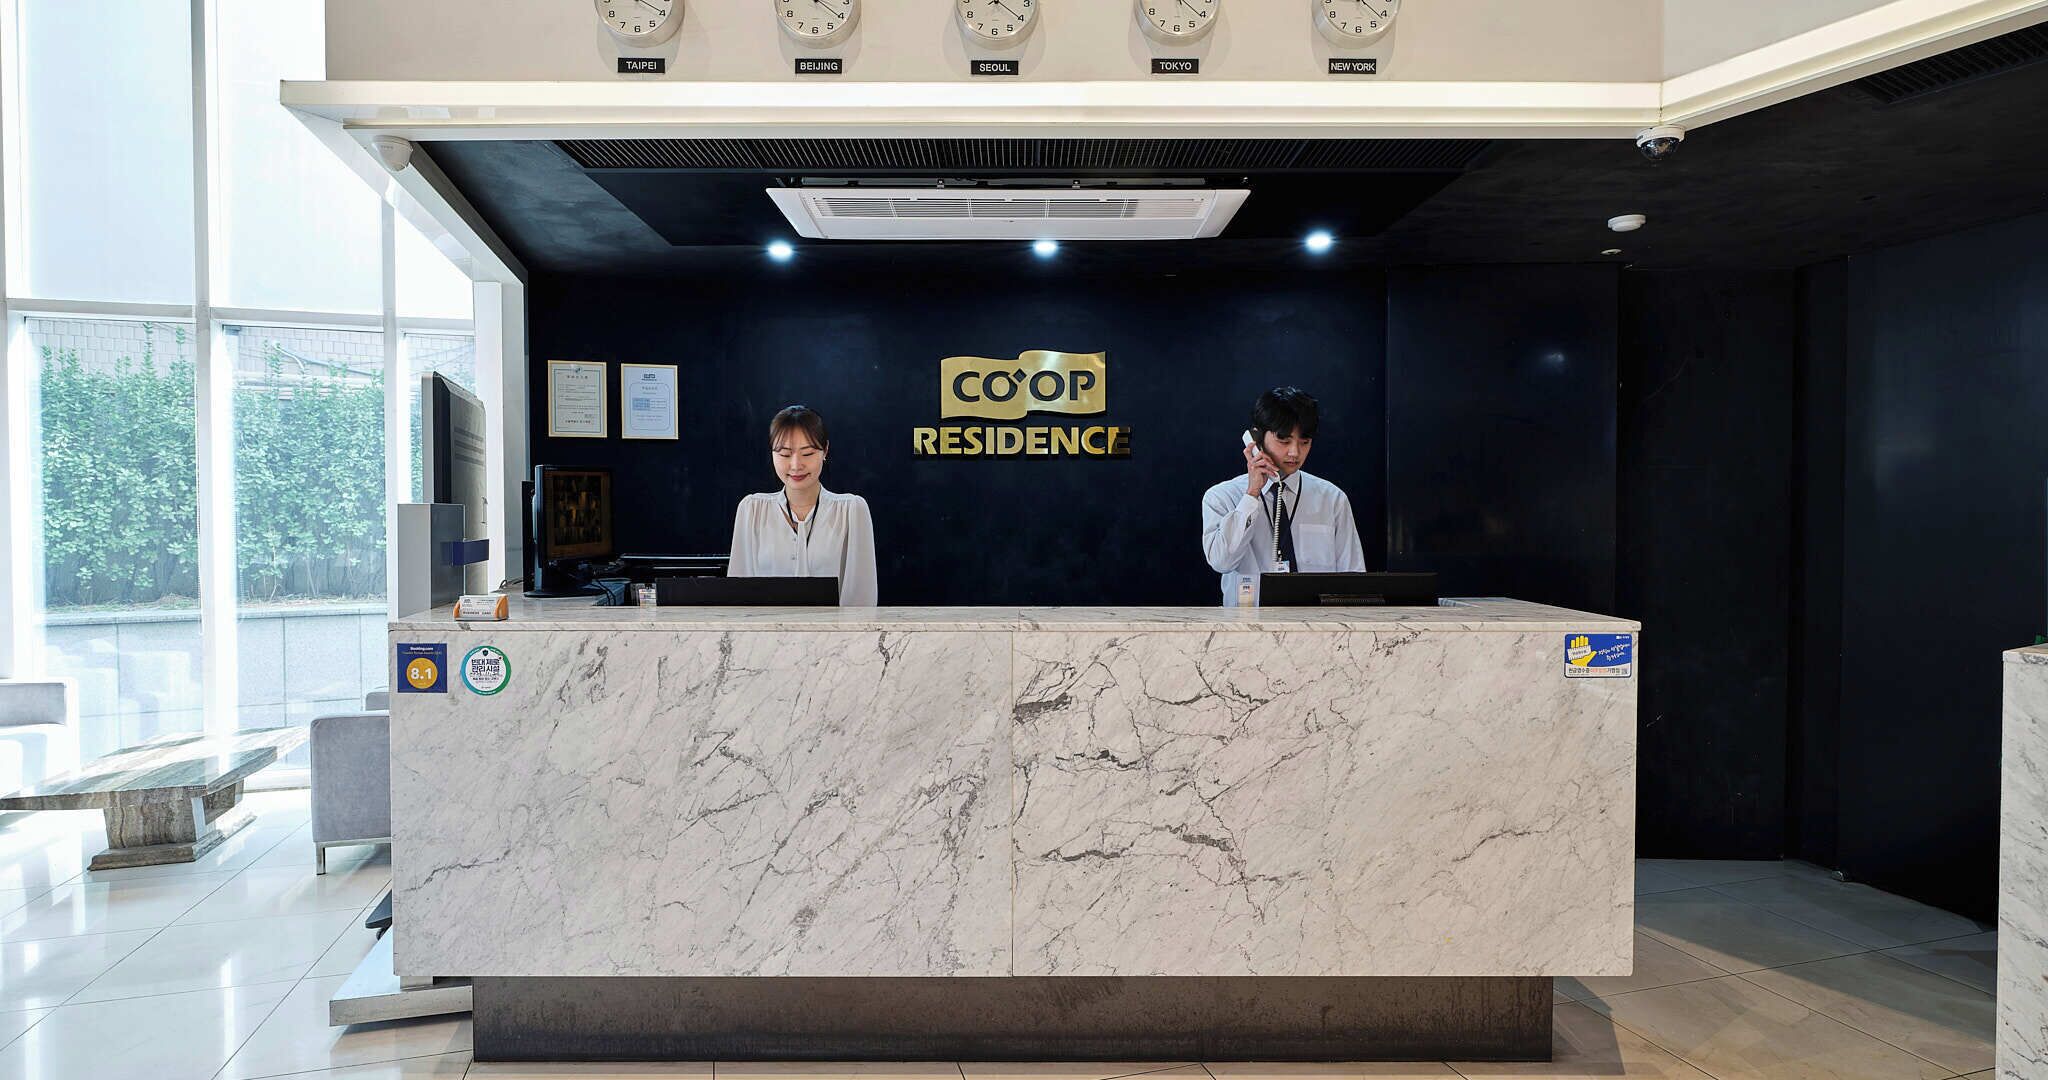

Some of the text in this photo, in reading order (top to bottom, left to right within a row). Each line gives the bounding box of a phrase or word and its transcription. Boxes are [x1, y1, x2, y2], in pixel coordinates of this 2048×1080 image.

[626, 61, 657, 70] TAIPEI
[800, 62, 838, 70] BEIJING
[979, 63, 1011, 72] SEOUL
[1160, 62, 1192, 70] TOKYO
[1330, 62, 1375, 71] NEW YORK
[913, 426, 1131, 455] RESIDENCE
[411, 667, 432, 680] 8.1
